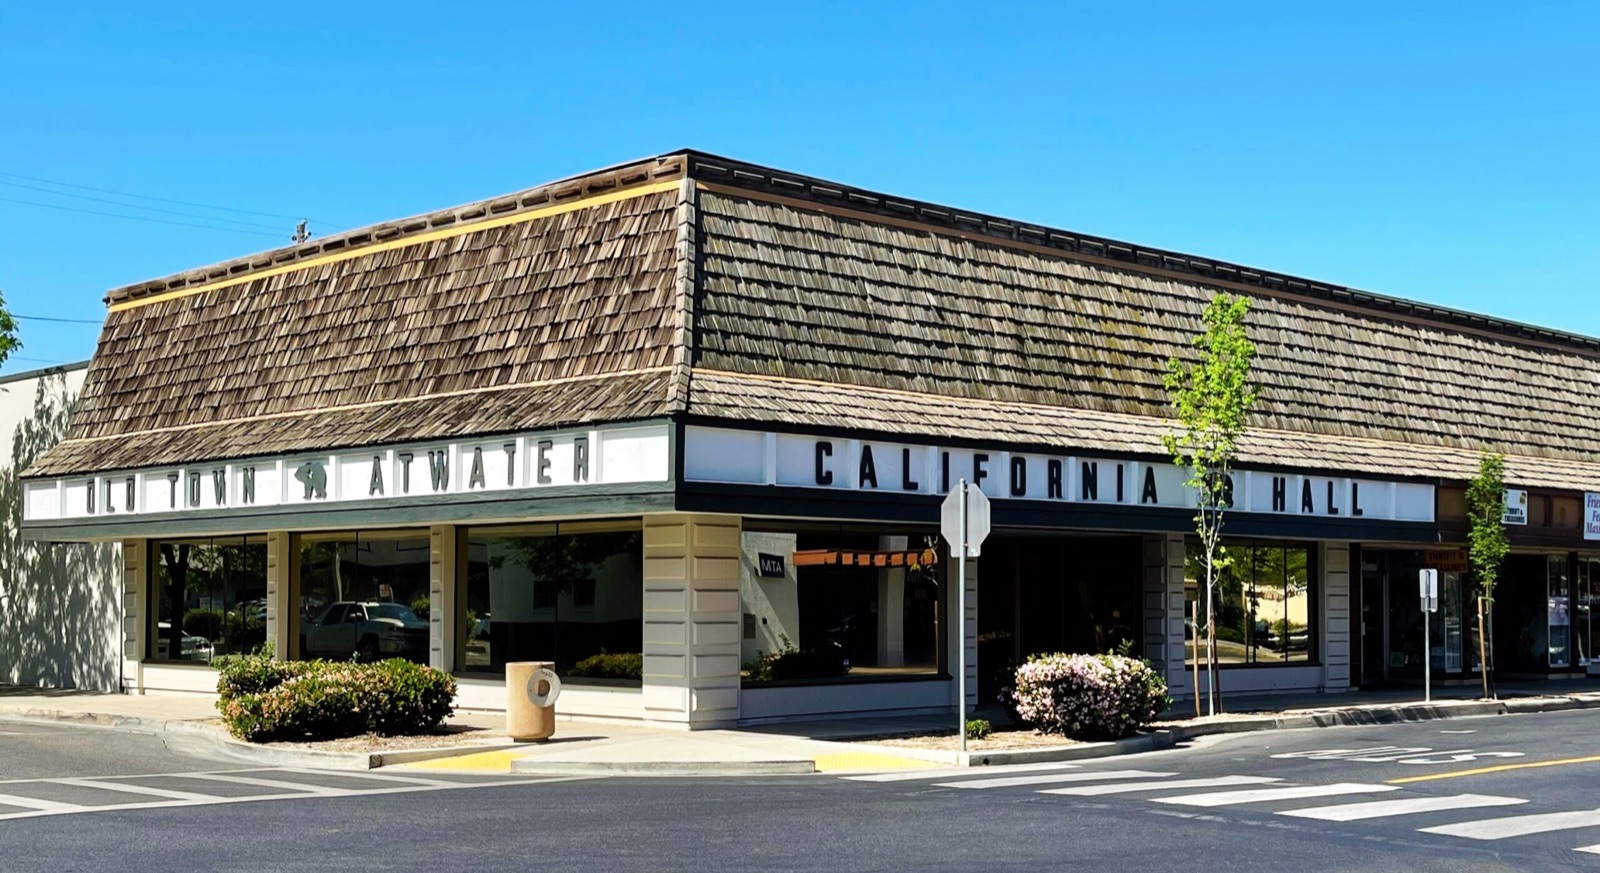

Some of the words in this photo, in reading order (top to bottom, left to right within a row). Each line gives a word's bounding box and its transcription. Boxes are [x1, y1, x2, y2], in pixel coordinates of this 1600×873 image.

[87, 477, 135, 514] OLD
[167, 467, 256, 508] TOWN
[369, 437, 589, 496] ATWATER
[815, 441, 1158, 505] CALIFORNIA
[1272, 476, 1363, 515] HALL
